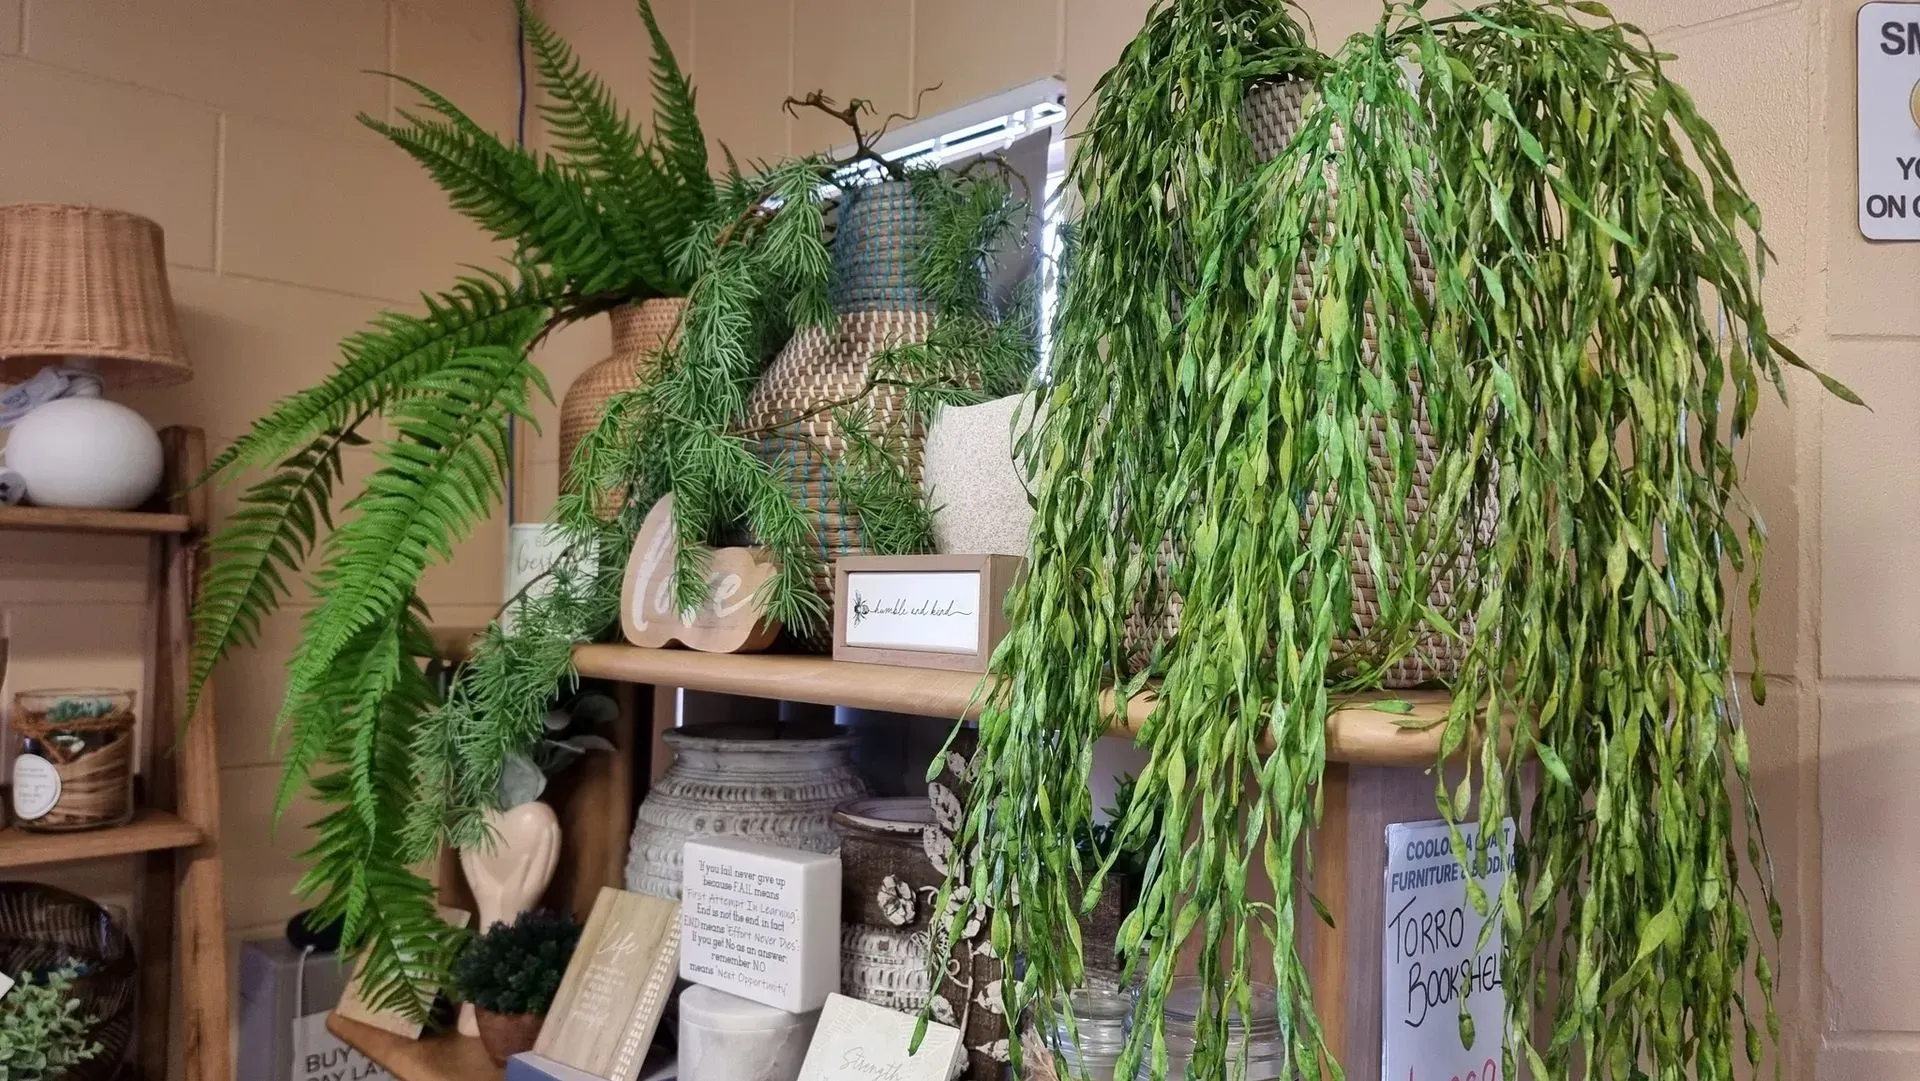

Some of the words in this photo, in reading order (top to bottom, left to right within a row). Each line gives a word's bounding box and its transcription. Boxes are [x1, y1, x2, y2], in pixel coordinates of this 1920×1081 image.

[1896, 156, 1920, 181] Y
[1866, 194, 1906, 218] ON
[632, 514, 754, 631] loe
[869, 598, 908, 616] humble
[911, 599, 931, 616] and
[931, 599, 973, 617] kind
[1406, 833, 1472, 861] COOLOA
[705, 865, 720, 876] you
[720, 864, 732, 877] fail
[734, 870, 756, 880] never
[757, 874, 774, 886] give
[775, 877, 786, 890] up
[1391, 863, 1459, 893] FURNITURE
[1472, 852, 1516, 878] BDDING
[703, 875, 732, 891] because
[733, 881, 753, 896] FAIL
[754, 888, 779, 901] means
[697, 902, 711, 916] End
[712, 908, 719, 917] is
[720, 908, 731, 920] not
[732, 909, 744, 923] the
[761, 918, 769, 929] in
[709, 893, 744, 910] Attempt
[747, 899, 758, 912] In
[683, 914, 700, 929] END
[700, 922, 725, 934] means
[754, 930, 777, 945] Never
[691, 929, 697, 942] If
[697, 934, 711, 947] you
[712, 937, 725, 950] get
[725, 937, 736, 950] No
[736, 943, 745, 953] as
[746, 945, 756, 956] an
[1388, 896, 1464, 964] TORRO
[689, 962, 714, 975] means
[711, 952, 751, 969] remember
[752, 959, 766, 973] NO
[1404, 953, 1503, 1028] BOOKSHEL
[305, 1046, 353, 1073] BUY
[305, 1068, 345, 1081] AY
